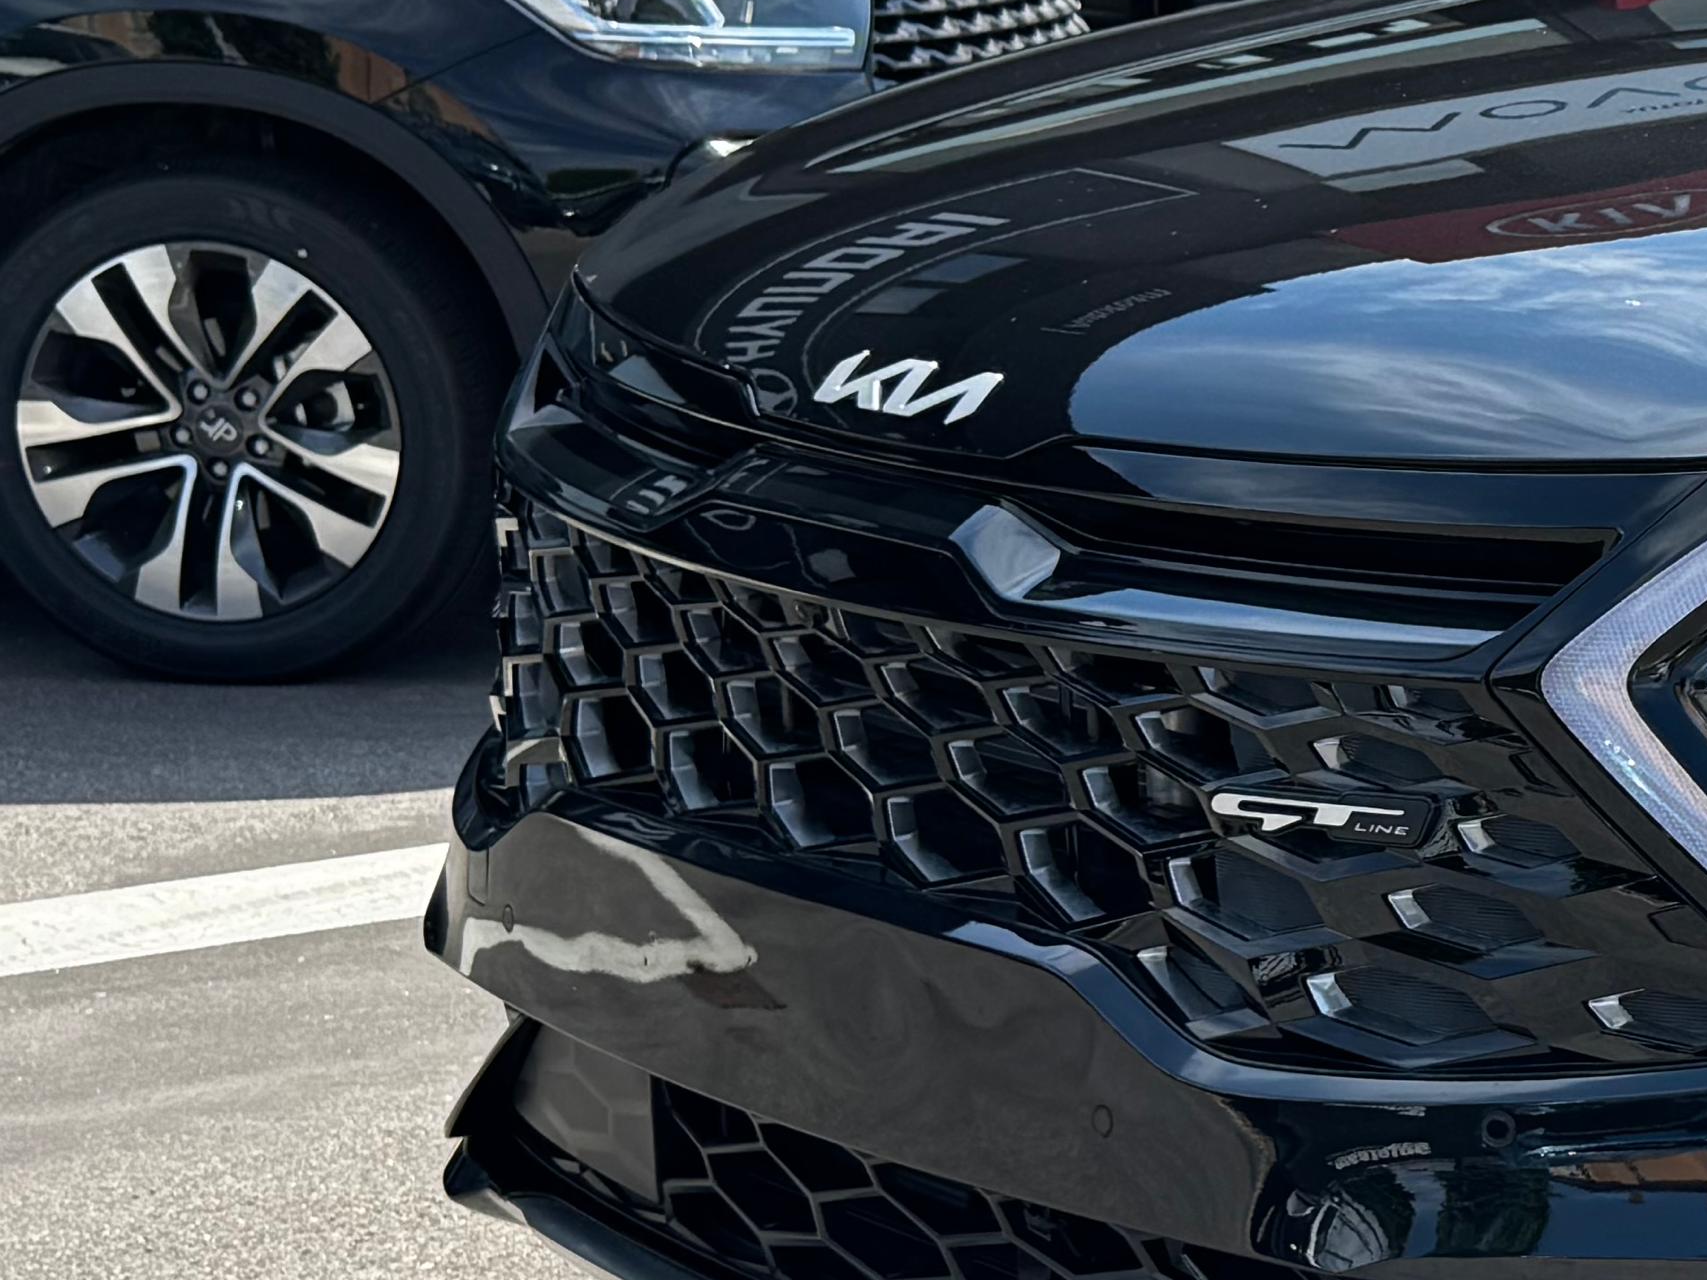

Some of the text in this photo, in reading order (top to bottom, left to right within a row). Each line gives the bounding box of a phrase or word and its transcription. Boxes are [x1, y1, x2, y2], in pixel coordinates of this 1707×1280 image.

[811, 350, 1005, 427] KIA
[1211, 792, 1405, 832] GT
[1353, 822, 1410, 836] LINE
